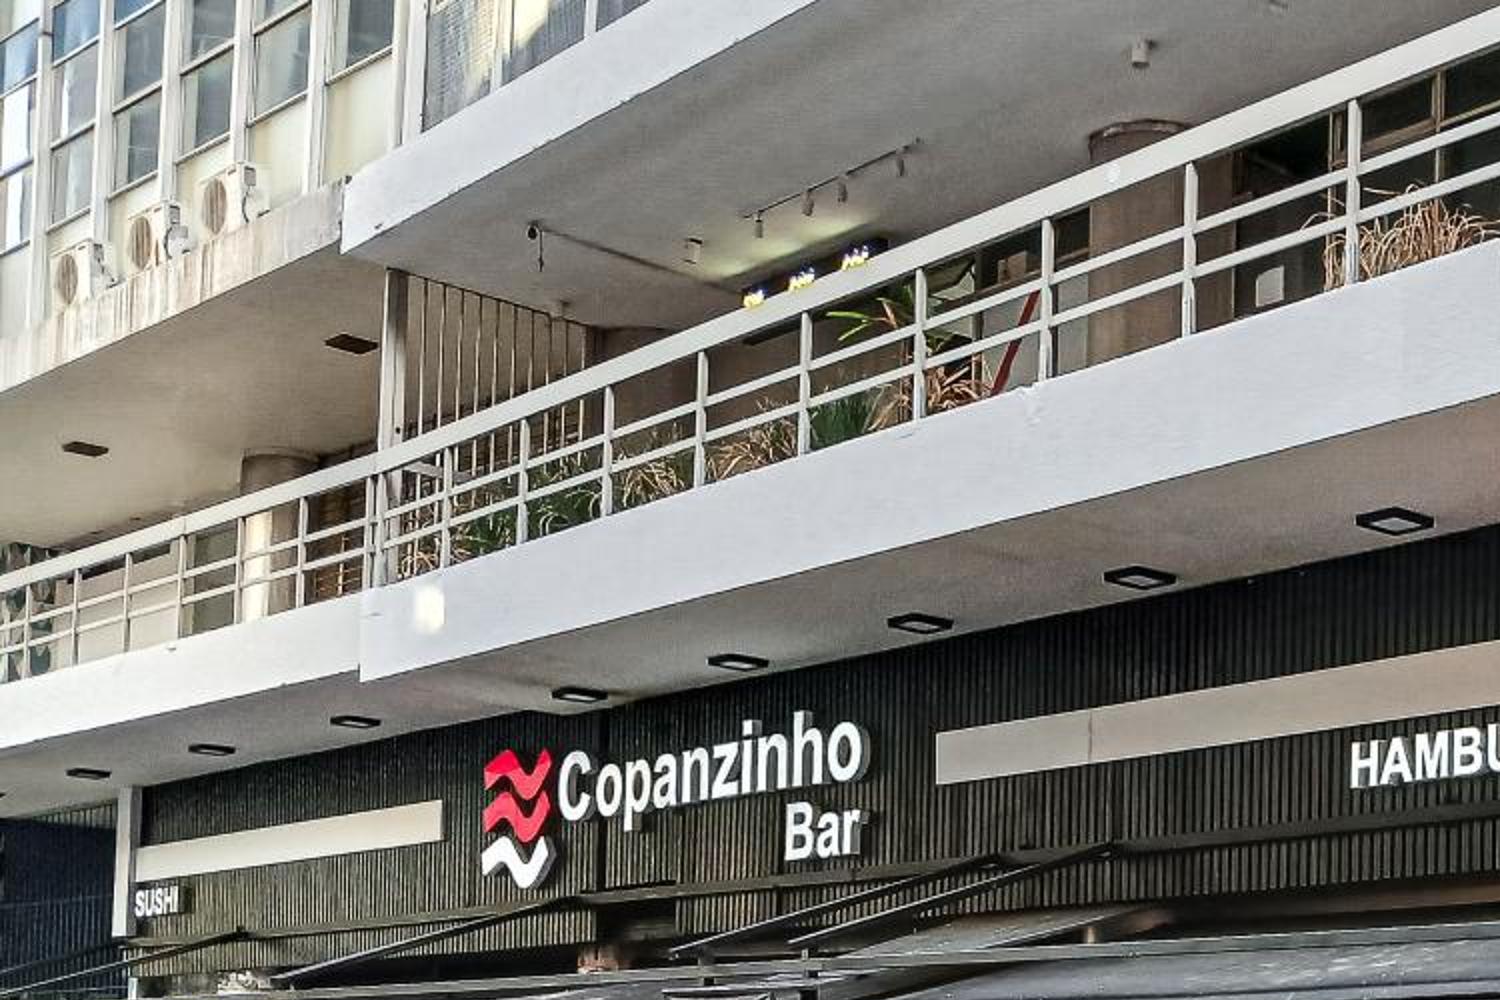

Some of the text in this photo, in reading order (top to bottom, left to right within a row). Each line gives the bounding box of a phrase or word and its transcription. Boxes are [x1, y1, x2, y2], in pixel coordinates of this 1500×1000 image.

[558, 710, 866, 832] Copanzinho
[784, 801, 864, 861] Bar
[135, 885, 179, 917] SUSHI
